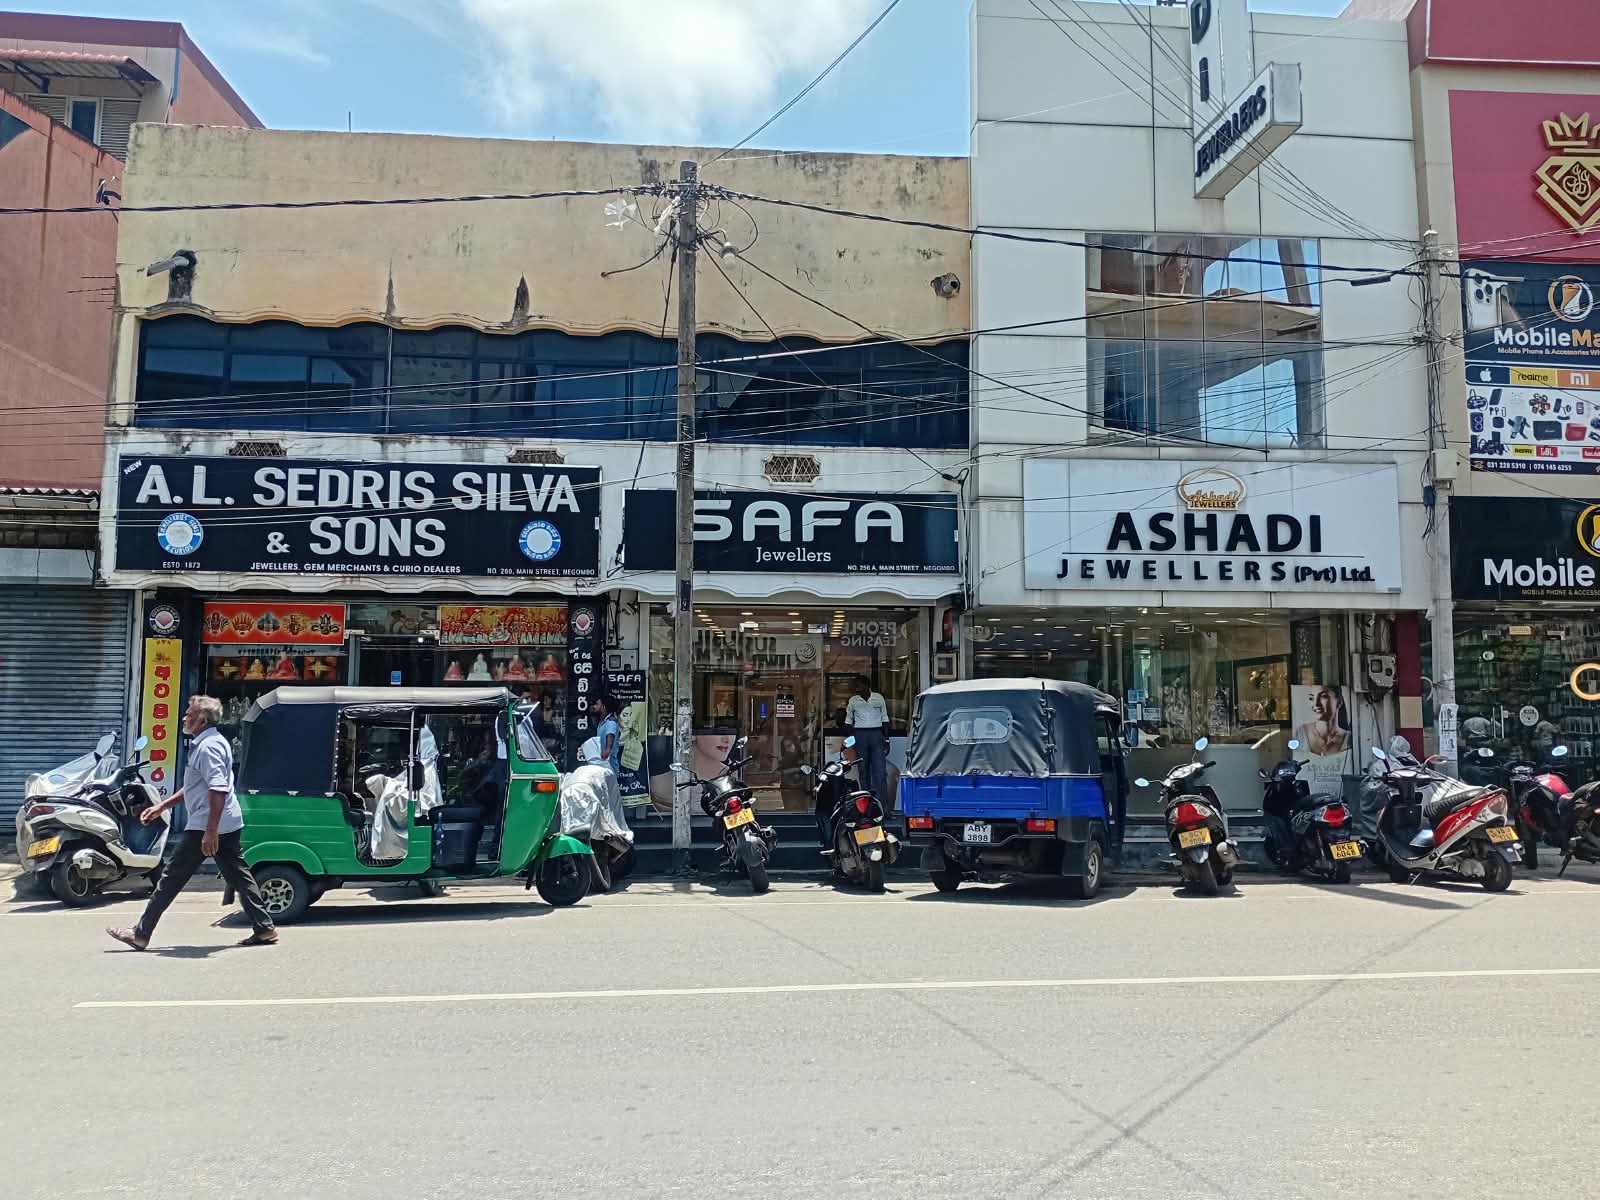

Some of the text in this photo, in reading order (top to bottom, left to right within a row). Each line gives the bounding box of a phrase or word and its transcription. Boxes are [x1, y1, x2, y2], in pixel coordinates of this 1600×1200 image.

[124, 459, 143, 475] NEW
[252, 466, 436, 511] SEDRIS
[451, 470, 580, 513] SILVA
[1190, 500, 1236, 509] JEWELLERS
[693, 499, 904, 542] SAFA
[266, 515, 446, 557] & SONS
[1106, 511, 1322, 553] ASHADI
[756, 546, 831, 562] Jewellers
[303, 563, 325, 571] GEM
[327, 563, 381, 572] MERCHANTS
[383, 564, 390, 572] &
[392, 564, 421, 573] CURIO
[423, 565, 461, 574] DEALERS
[562, 568, 595, 576] NEGOMBO
[1056, 558, 1287, 582] JEWELLERS
[1294, 564, 1337, 584] (Pvt)
[1483, 557, 1596, 587] Mobile
[608, 674, 641, 683] SAFA
